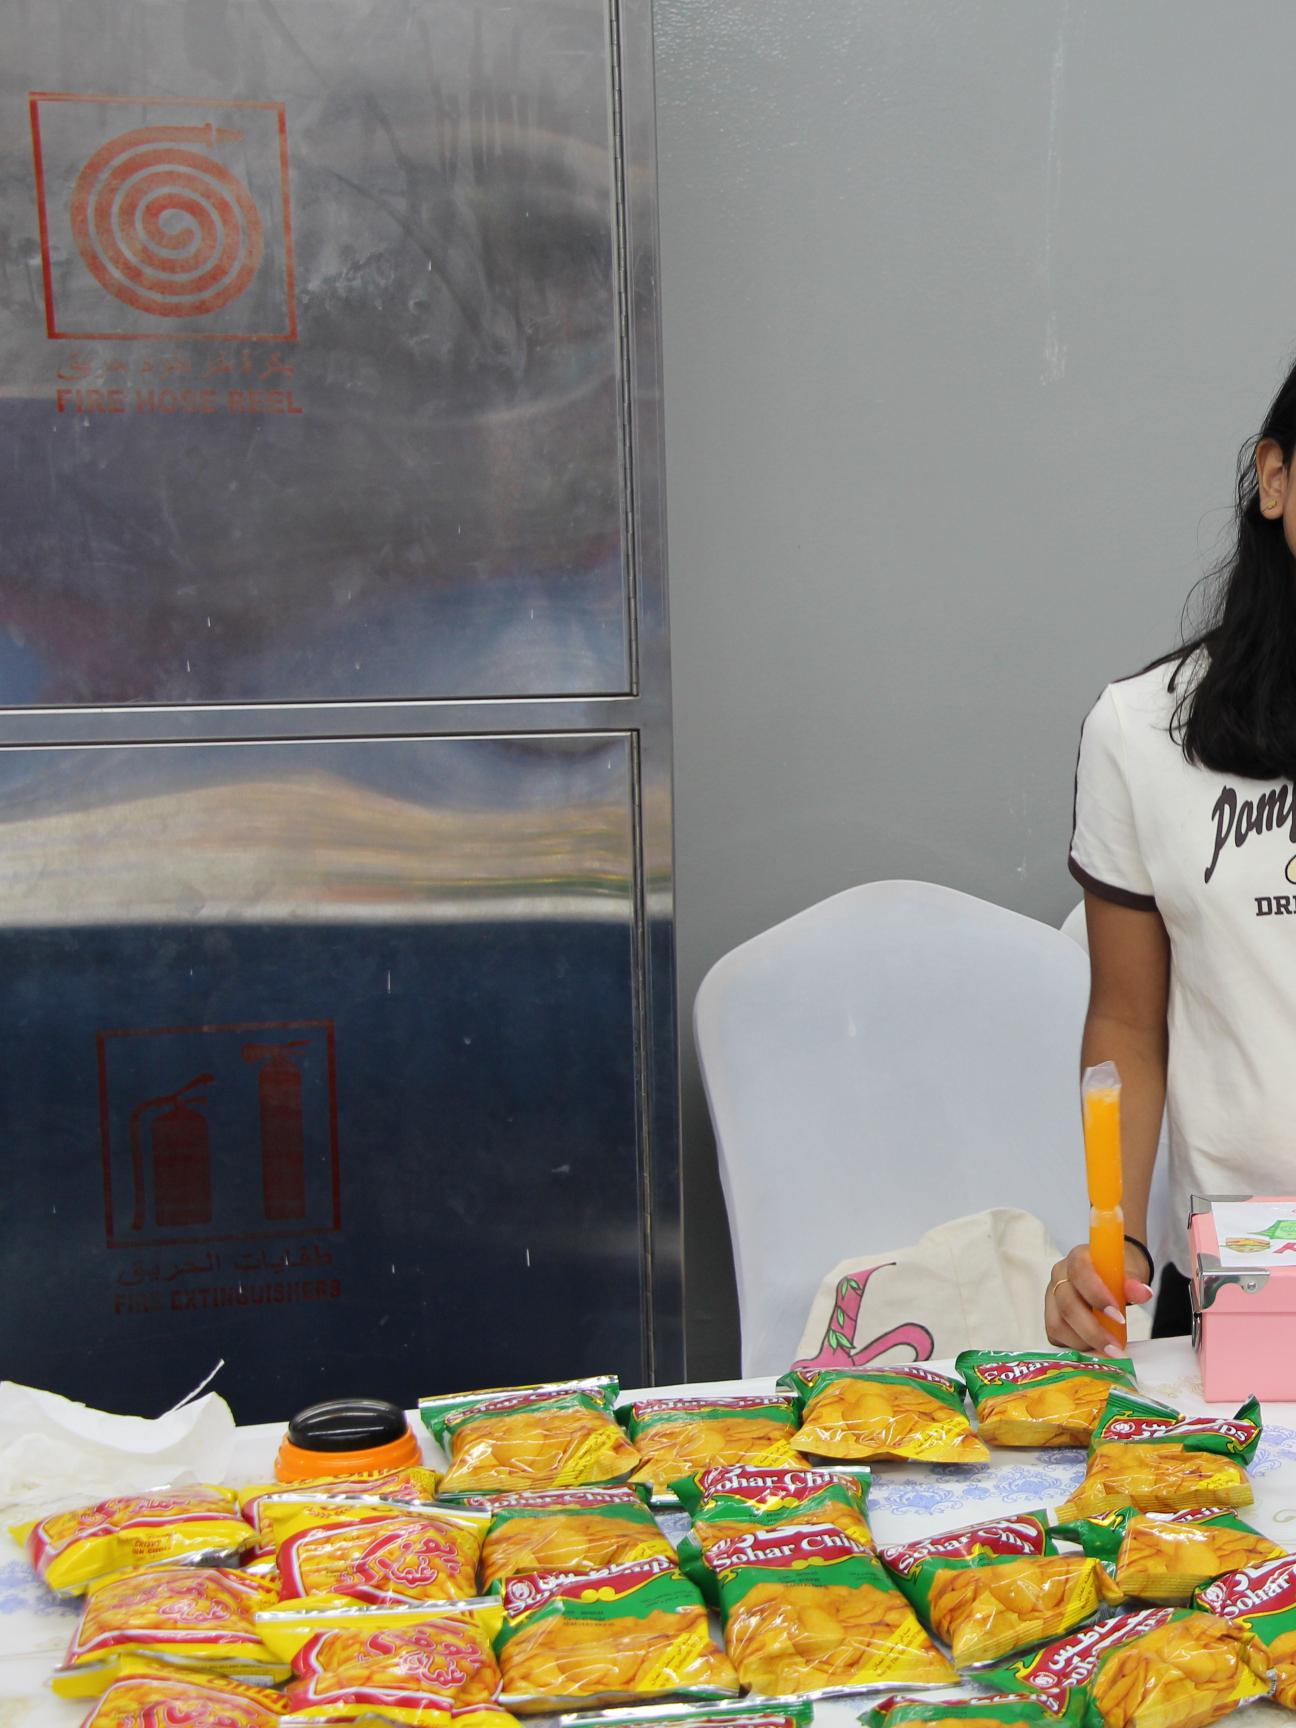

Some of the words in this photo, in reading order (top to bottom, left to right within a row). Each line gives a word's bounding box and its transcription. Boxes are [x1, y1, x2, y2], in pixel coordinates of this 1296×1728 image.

[55, 388, 126, 414] FIRE
[135, 389, 217, 414] HOSE
[228, 389, 303, 414] REEL
[114, 1293, 163, 1315] FIRE
[170, 1278, 342, 1312] EXTINGUISHERS
[712, 1543, 796, 1573] Sohar
[899, 1533, 971, 1575] Sohar
